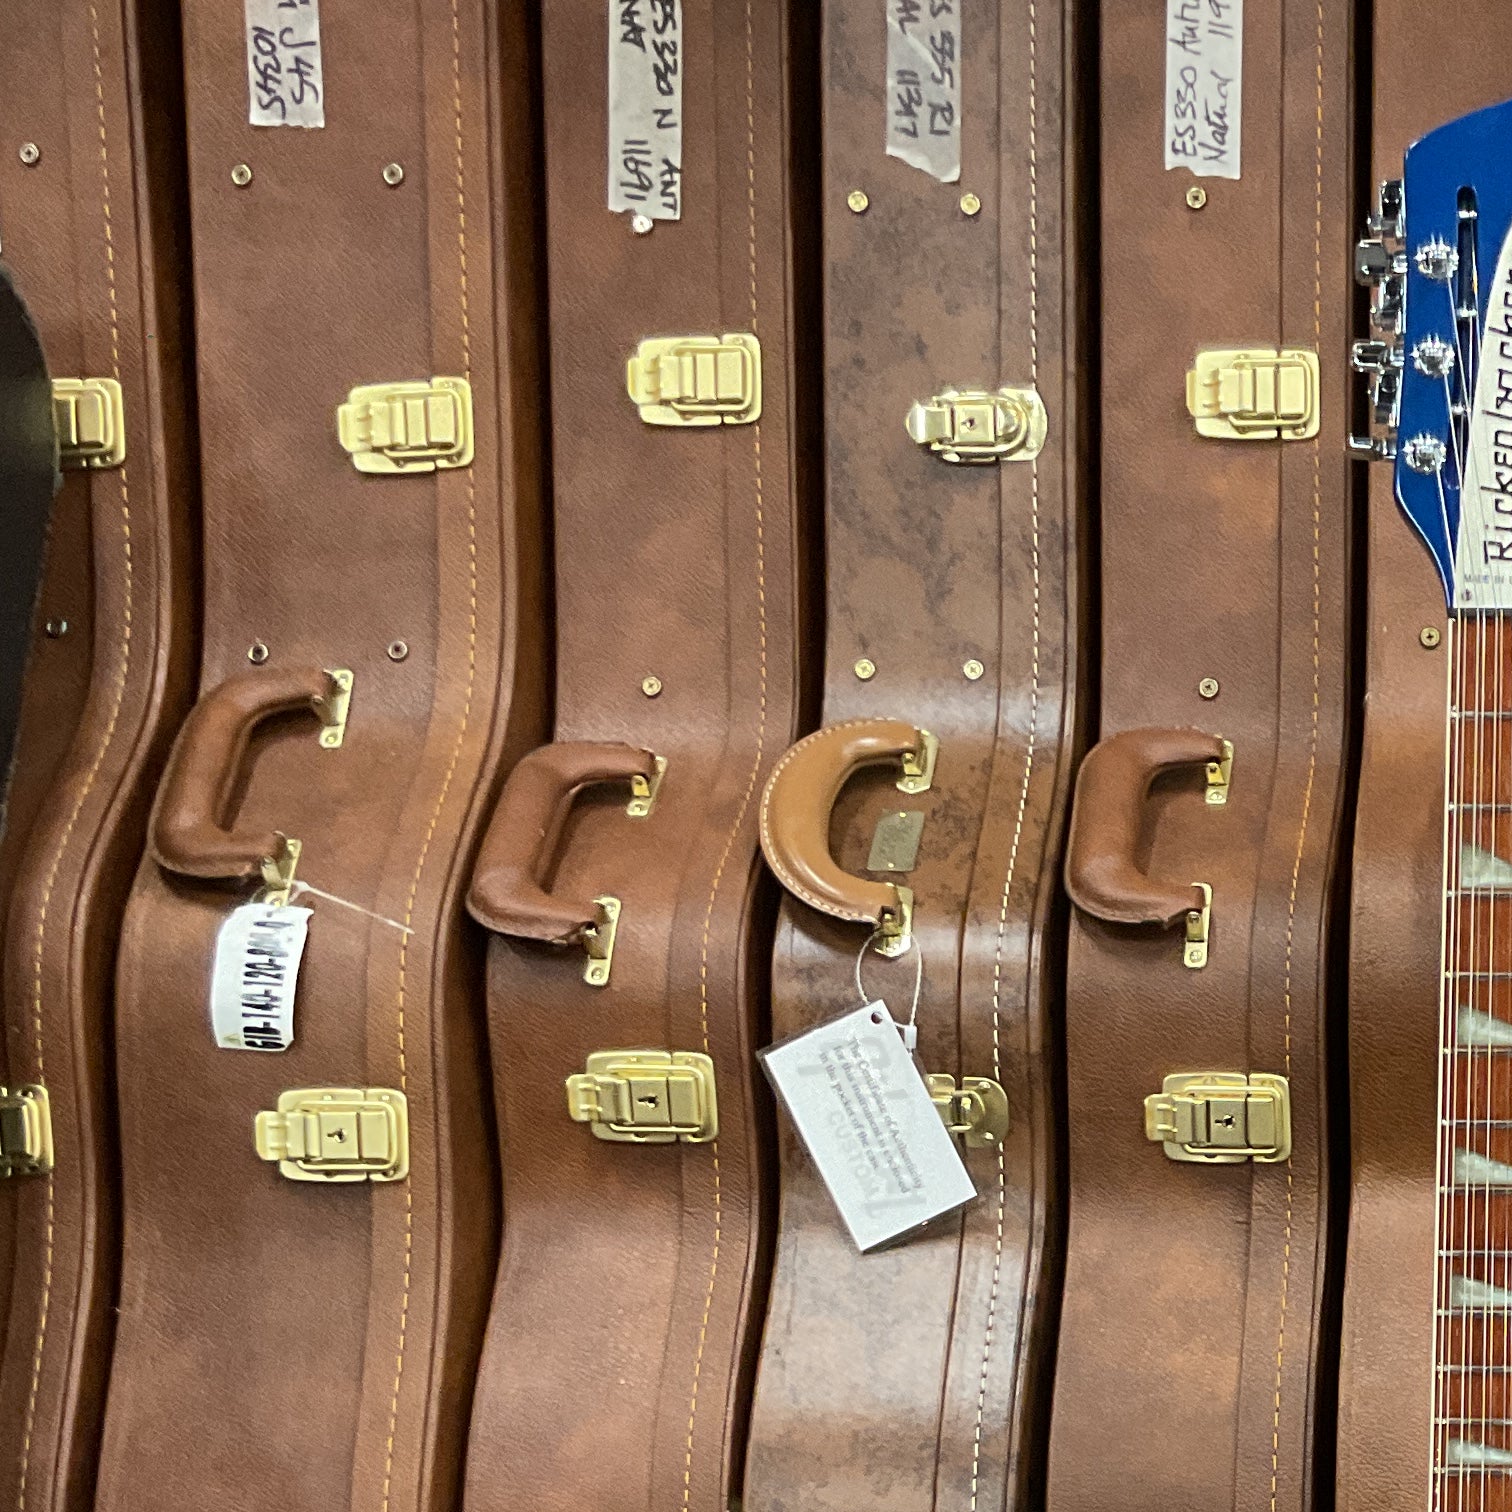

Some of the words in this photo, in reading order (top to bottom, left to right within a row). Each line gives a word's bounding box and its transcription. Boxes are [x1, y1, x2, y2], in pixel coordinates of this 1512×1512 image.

[252, 26, 286, 120] 10345
[653, 108, 677, 129] N
[620, 139, 652, 200] 11691
